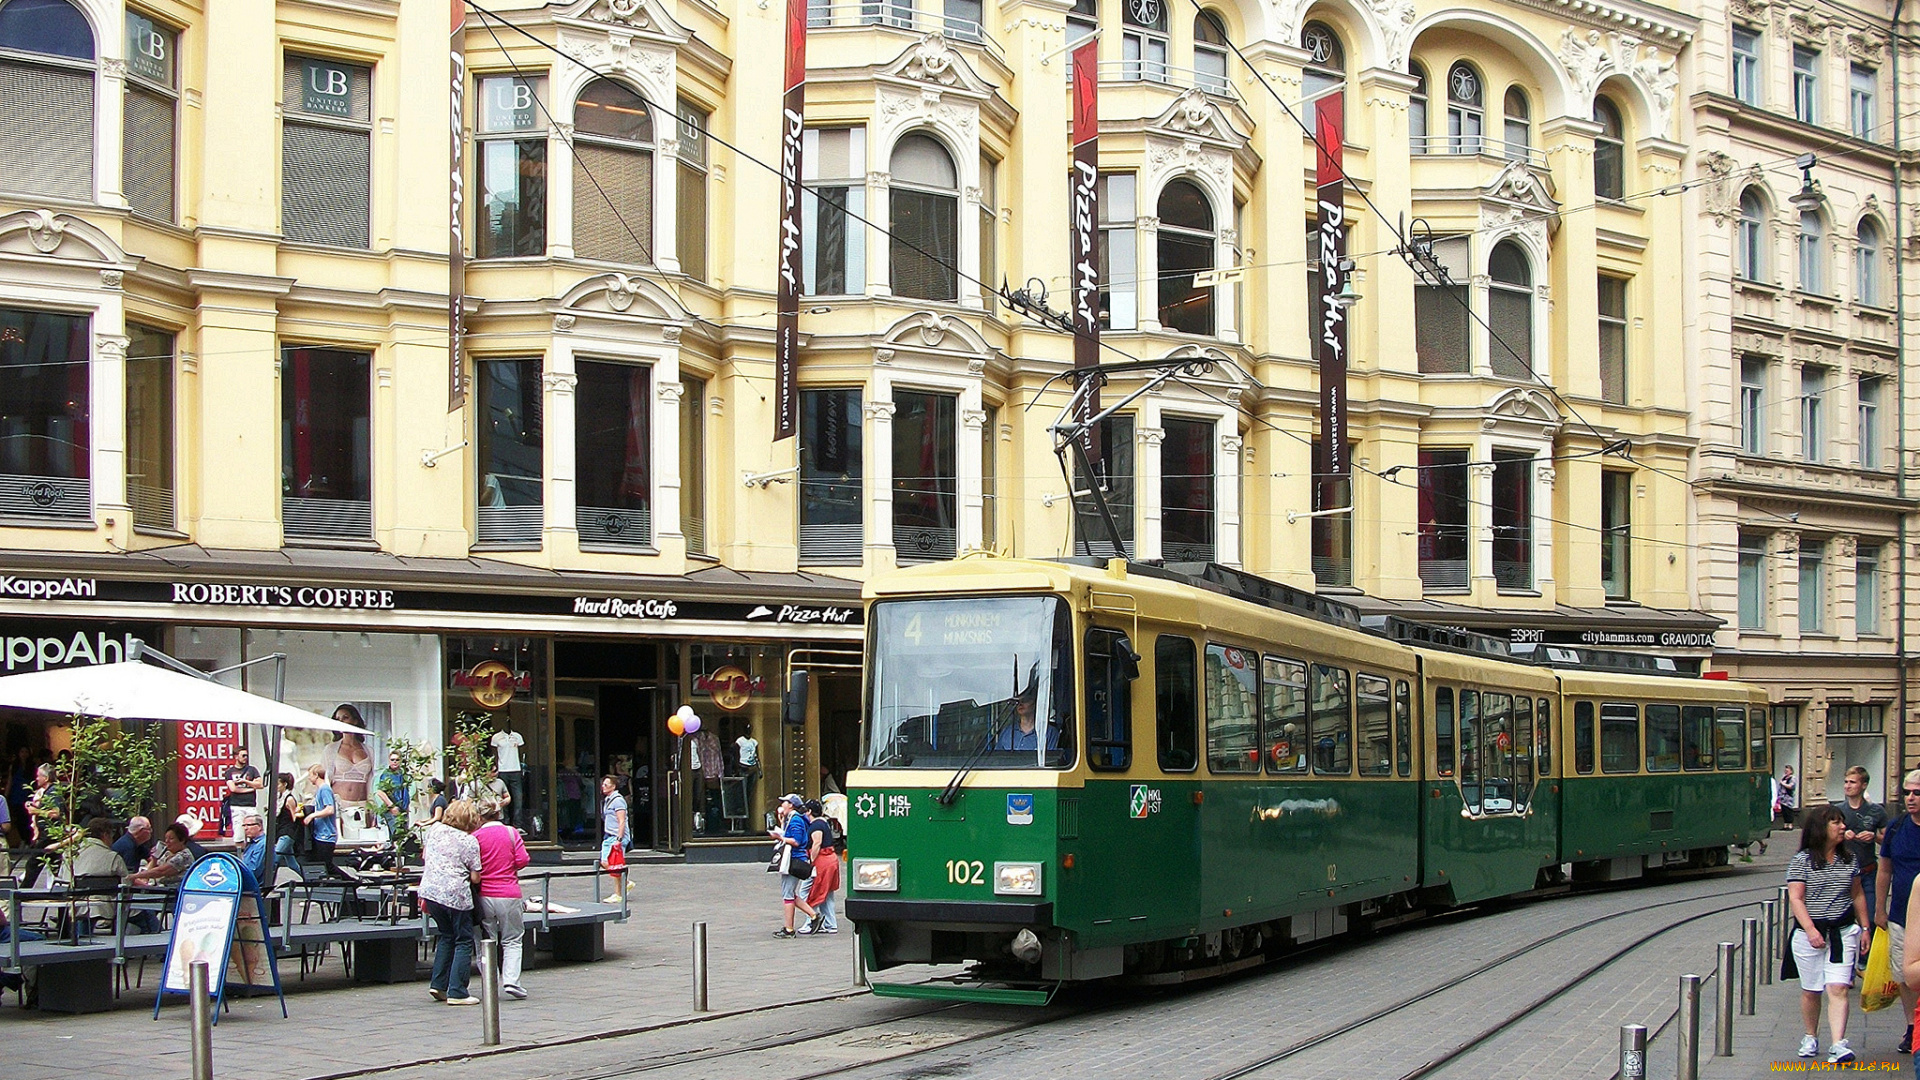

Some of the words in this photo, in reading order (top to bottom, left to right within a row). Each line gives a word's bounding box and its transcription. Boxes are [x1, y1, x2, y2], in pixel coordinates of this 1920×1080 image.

[135, 23, 165, 60] UB
[309, 66, 348, 96] UB
[306, 102, 348, 113] BANKERS
[309, 96, 345, 107] UNITED
[451, 51, 464, 163] Pizza
[496, 85, 532, 110] UB
[493, 119, 532, 127] BANKERS
[679, 109, 699, 140] UB
[783, 107, 803, 211] Pizza
[451, 167, 463, 254] Hut
[1075, 159, 1098, 257] Pizza
[781, 214, 800, 296] Hut
[1318, 200, 1343, 289] Pizza
[1077, 258, 1098, 334] Hut
[1322, 292, 1344, 361] Hut
[782, 326, 791, 431] www.pizzahut.fi
[1330, 385, 1340, 474] www.pizzahut.fi
[0, 576, 97, 599] KappAhl
[172, 583, 292, 606] ROBERT'S
[297, 586, 395, 609] COFFEE
[573, 597, 611, 614] Hard
[610, 598, 645, 618] Rock
[645, 599, 678, 619] Cafe
[777, 604, 821, 622] Pizza
[821, 606, 854, 623] Hut
[904, 611, 923, 647] 4
[1511, 629, 1545, 642] ESPRIT
[1582, 630, 1655, 645] cityhammas.com
[1661, 633, 1717, 646] GRAVIDITAS
[183, 722, 233, 739] SALE!
[184, 743, 234, 760] SALE!
[185, 764, 235, 781] SALE
[888, 795, 911, 806] HSL
[1148, 789, 1162, 801] HKL
[186, 806, 222, 823] SAL
[888, 806, 911, 817] HRT
[1148, 801, 1162, 813] HST
[946, 860, 985, 884] 102
